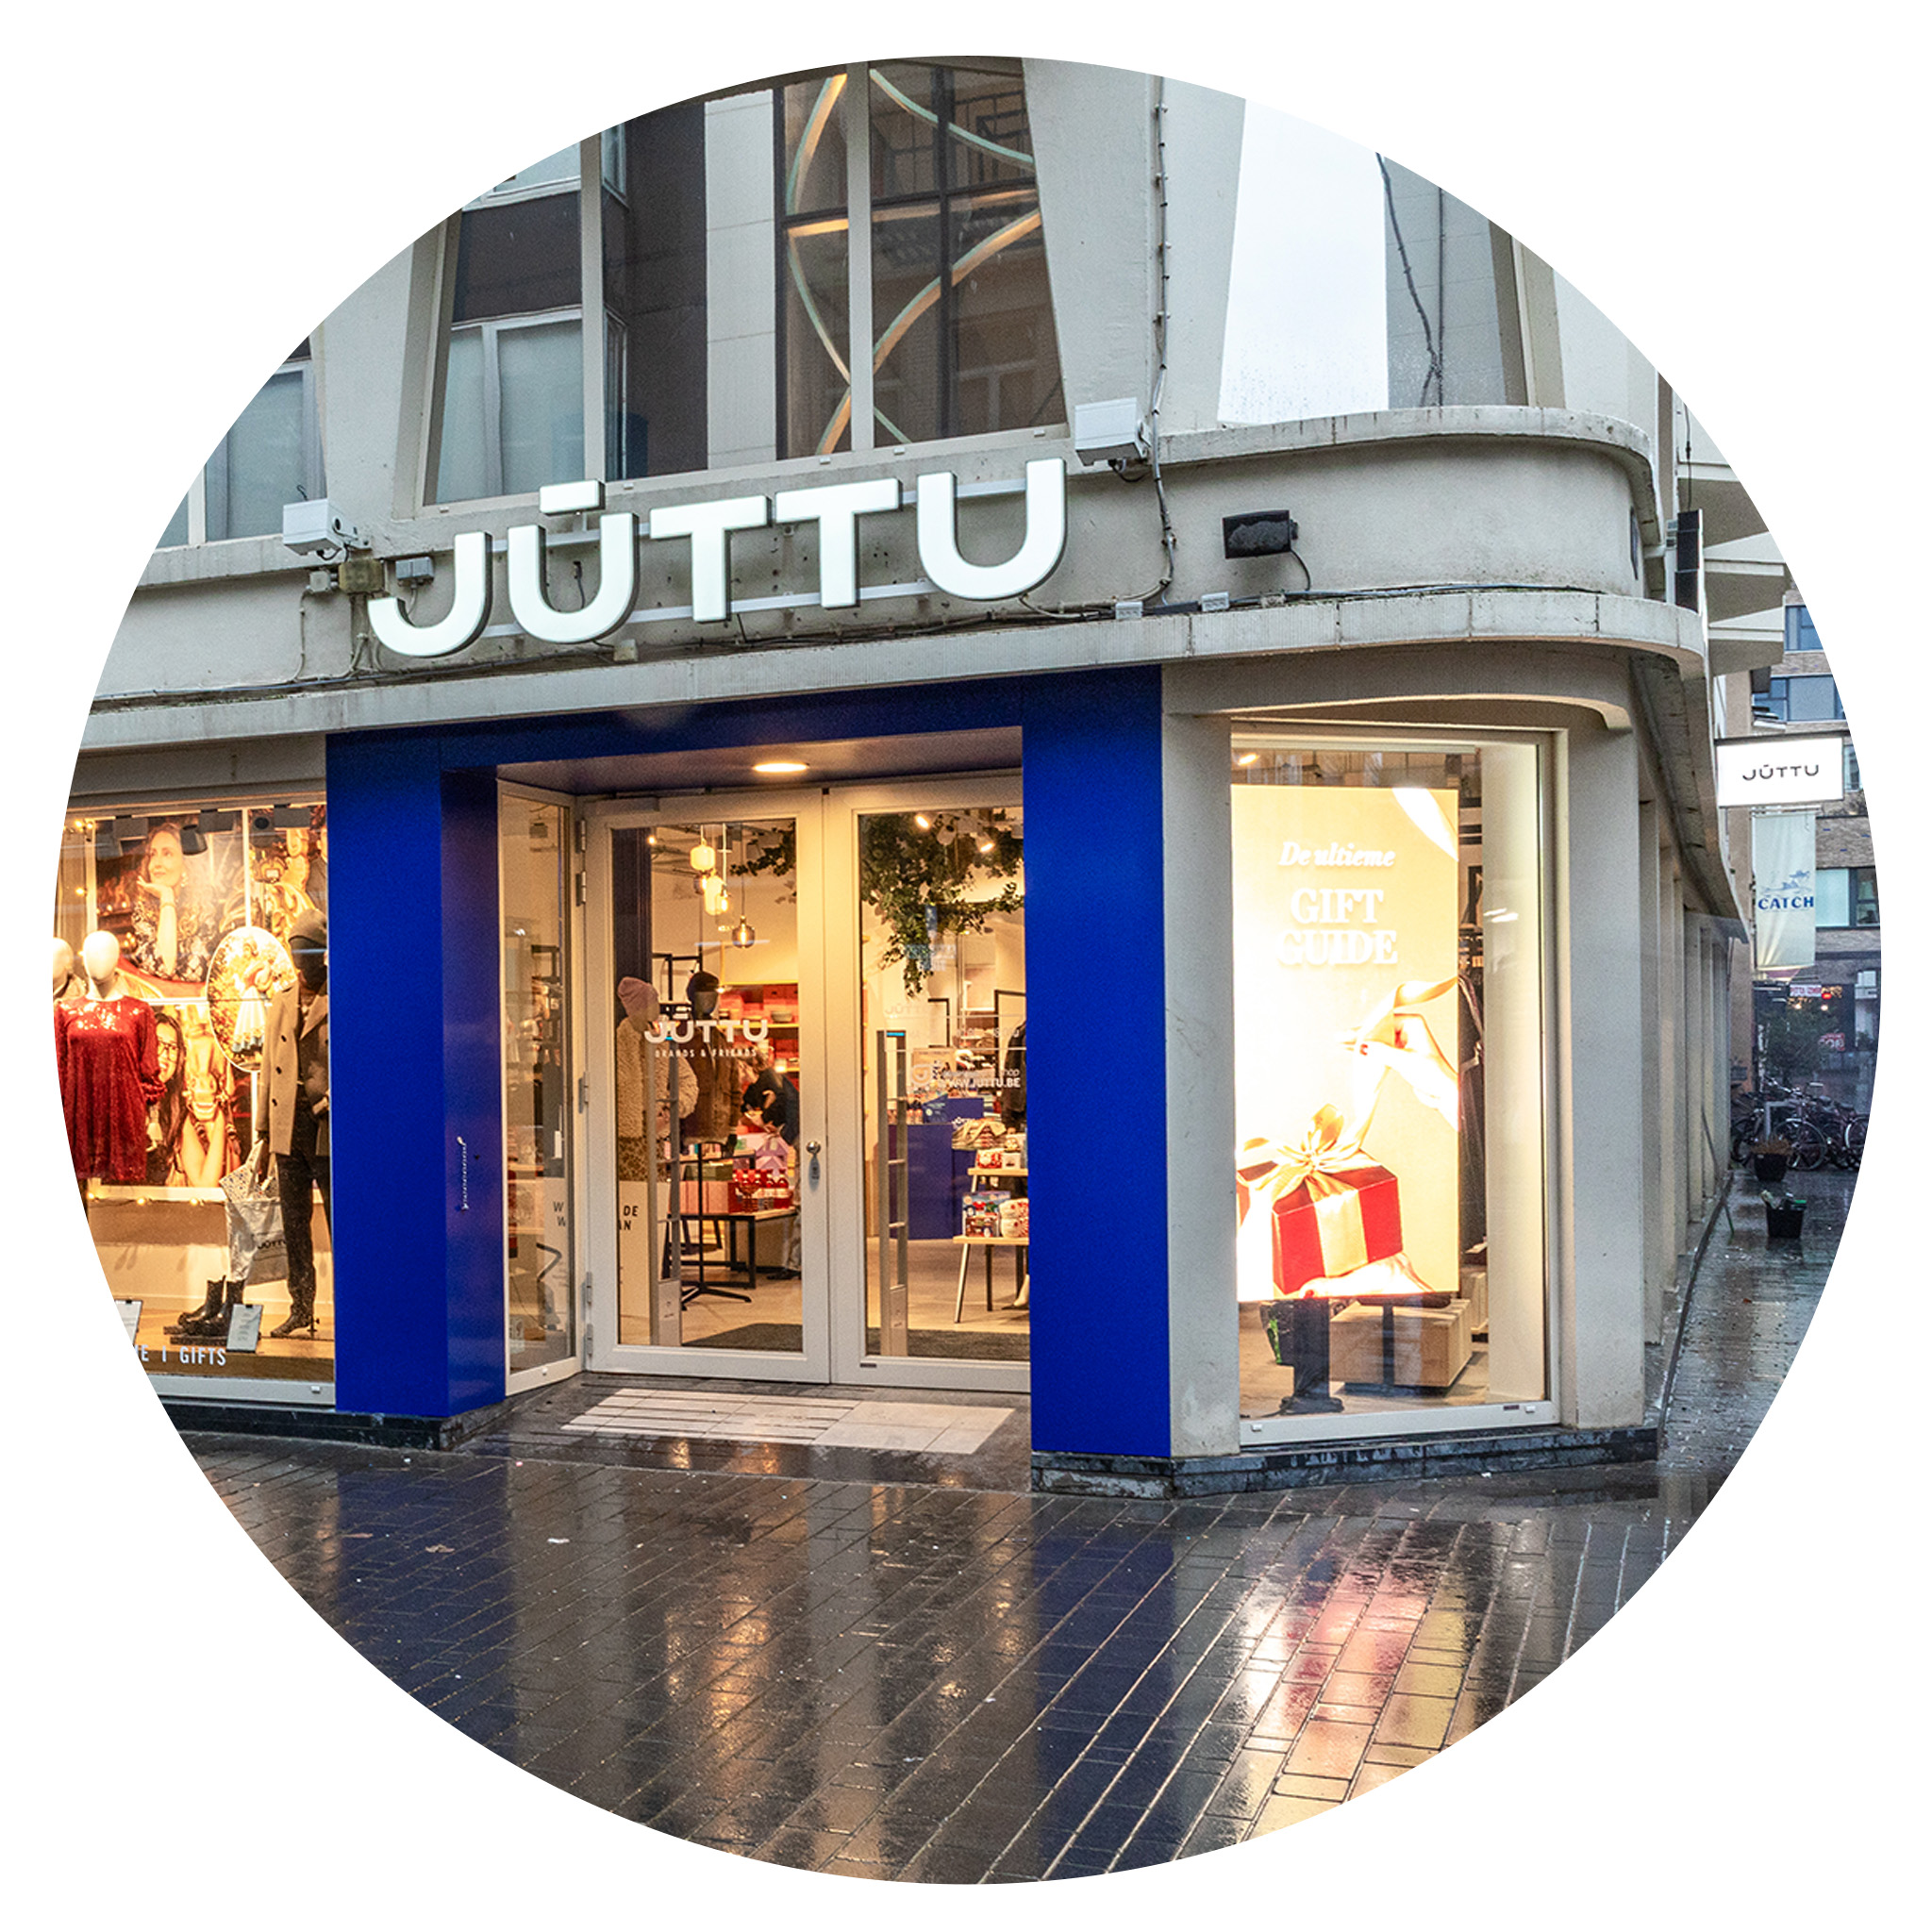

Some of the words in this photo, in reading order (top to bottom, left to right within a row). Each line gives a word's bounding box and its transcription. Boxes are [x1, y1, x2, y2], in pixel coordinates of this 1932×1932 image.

[1277, 841, 1311, 866] De
[1313, 842, 1396, 867] ultieme
[1291, 888, 1384, 924] GIFT
[1757, 895, 1814, 910] CATCH
[1277, 929, 1398, 965] GUIDE
[623, 1205, 639, 1217] DE
[179, 1345, 226, 1367] GIFTS
